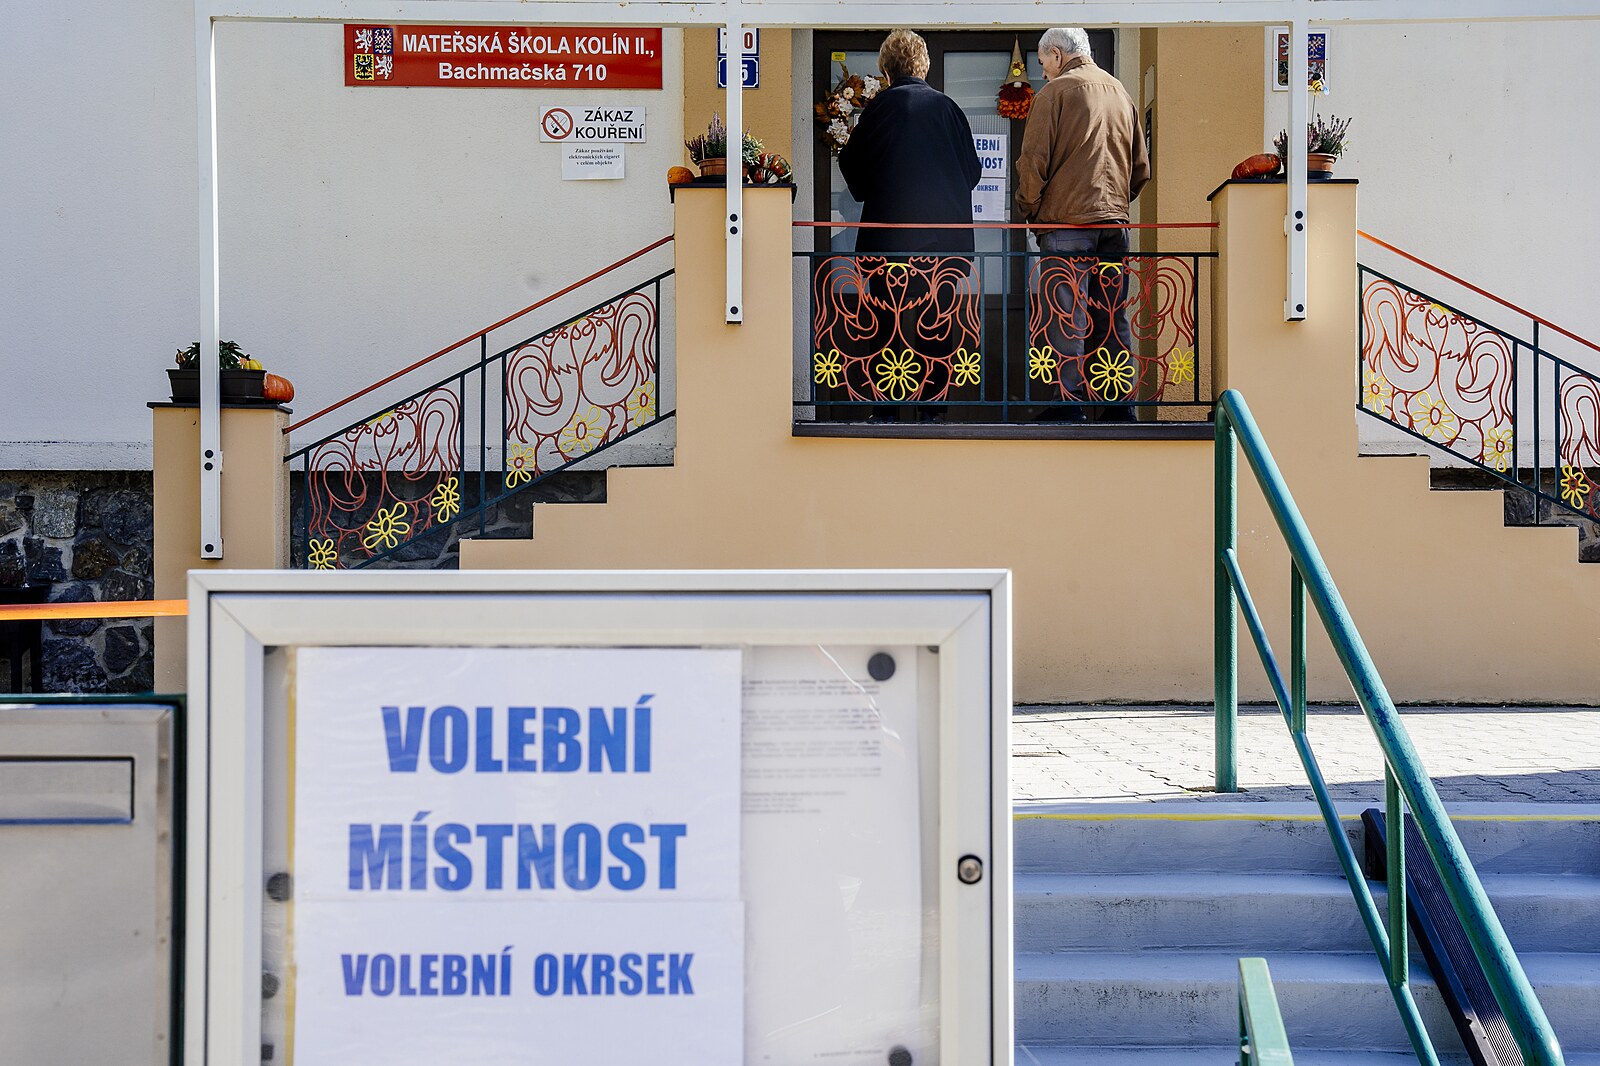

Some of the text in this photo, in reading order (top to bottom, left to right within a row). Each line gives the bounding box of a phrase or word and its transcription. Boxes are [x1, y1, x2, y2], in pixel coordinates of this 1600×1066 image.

[402, 31, 655, 57] MATEŘSKÁ ŠKOLA KOLÍN II.,
[438, 62, 608, 81] Bachmačská 710
[584, 107, 634, 123] ZÁKAZ
[575, 123, 645, 140] KOUŘENÍ
[976, 137, 1000, 151] EBNÍ
[976, 184, 999, 192] OKRSEK
[381, 694, 656, 774] VOLEBNÍ
[347, 811, 688, 892] MÍSTNOST
[341, 946, 695, 996] VOLEBNÍ OKRSEK
